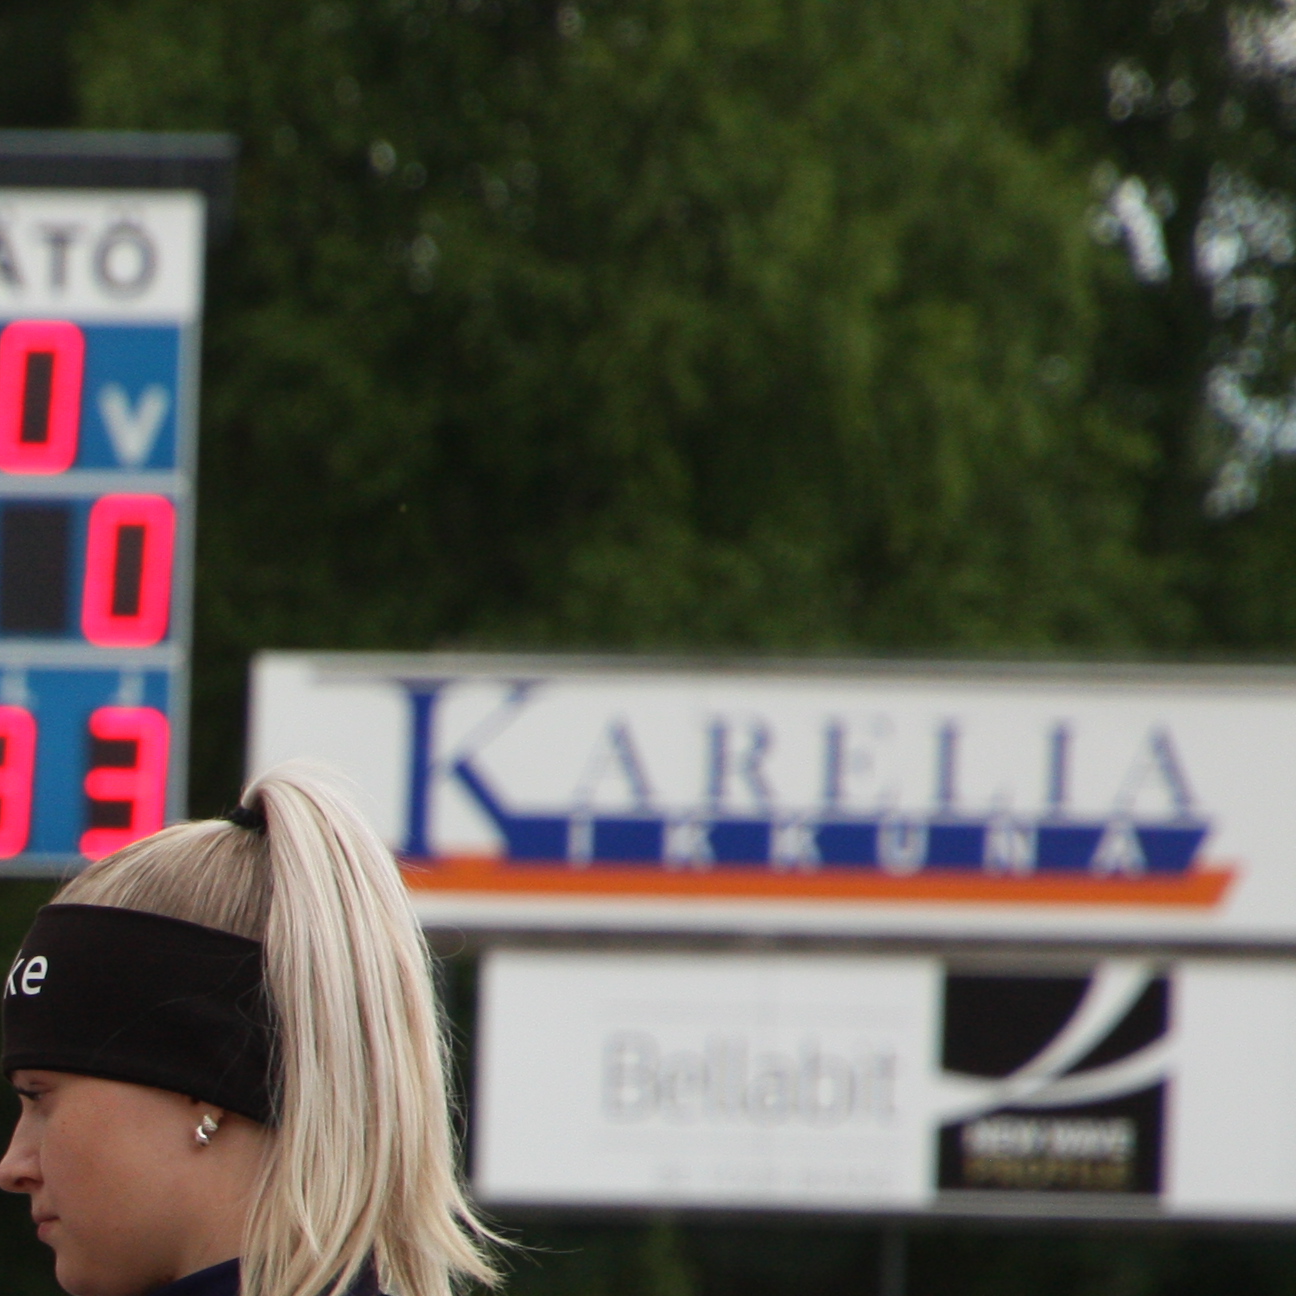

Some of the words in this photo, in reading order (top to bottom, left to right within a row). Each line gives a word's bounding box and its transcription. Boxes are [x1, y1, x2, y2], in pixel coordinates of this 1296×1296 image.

[99, 387, 166, 467] V
[398, 676, 1204, 858] KARELIA
[565, 812, 1150, 877] IKKUNA
[603, 1028, 900, 1126] Bellabit
